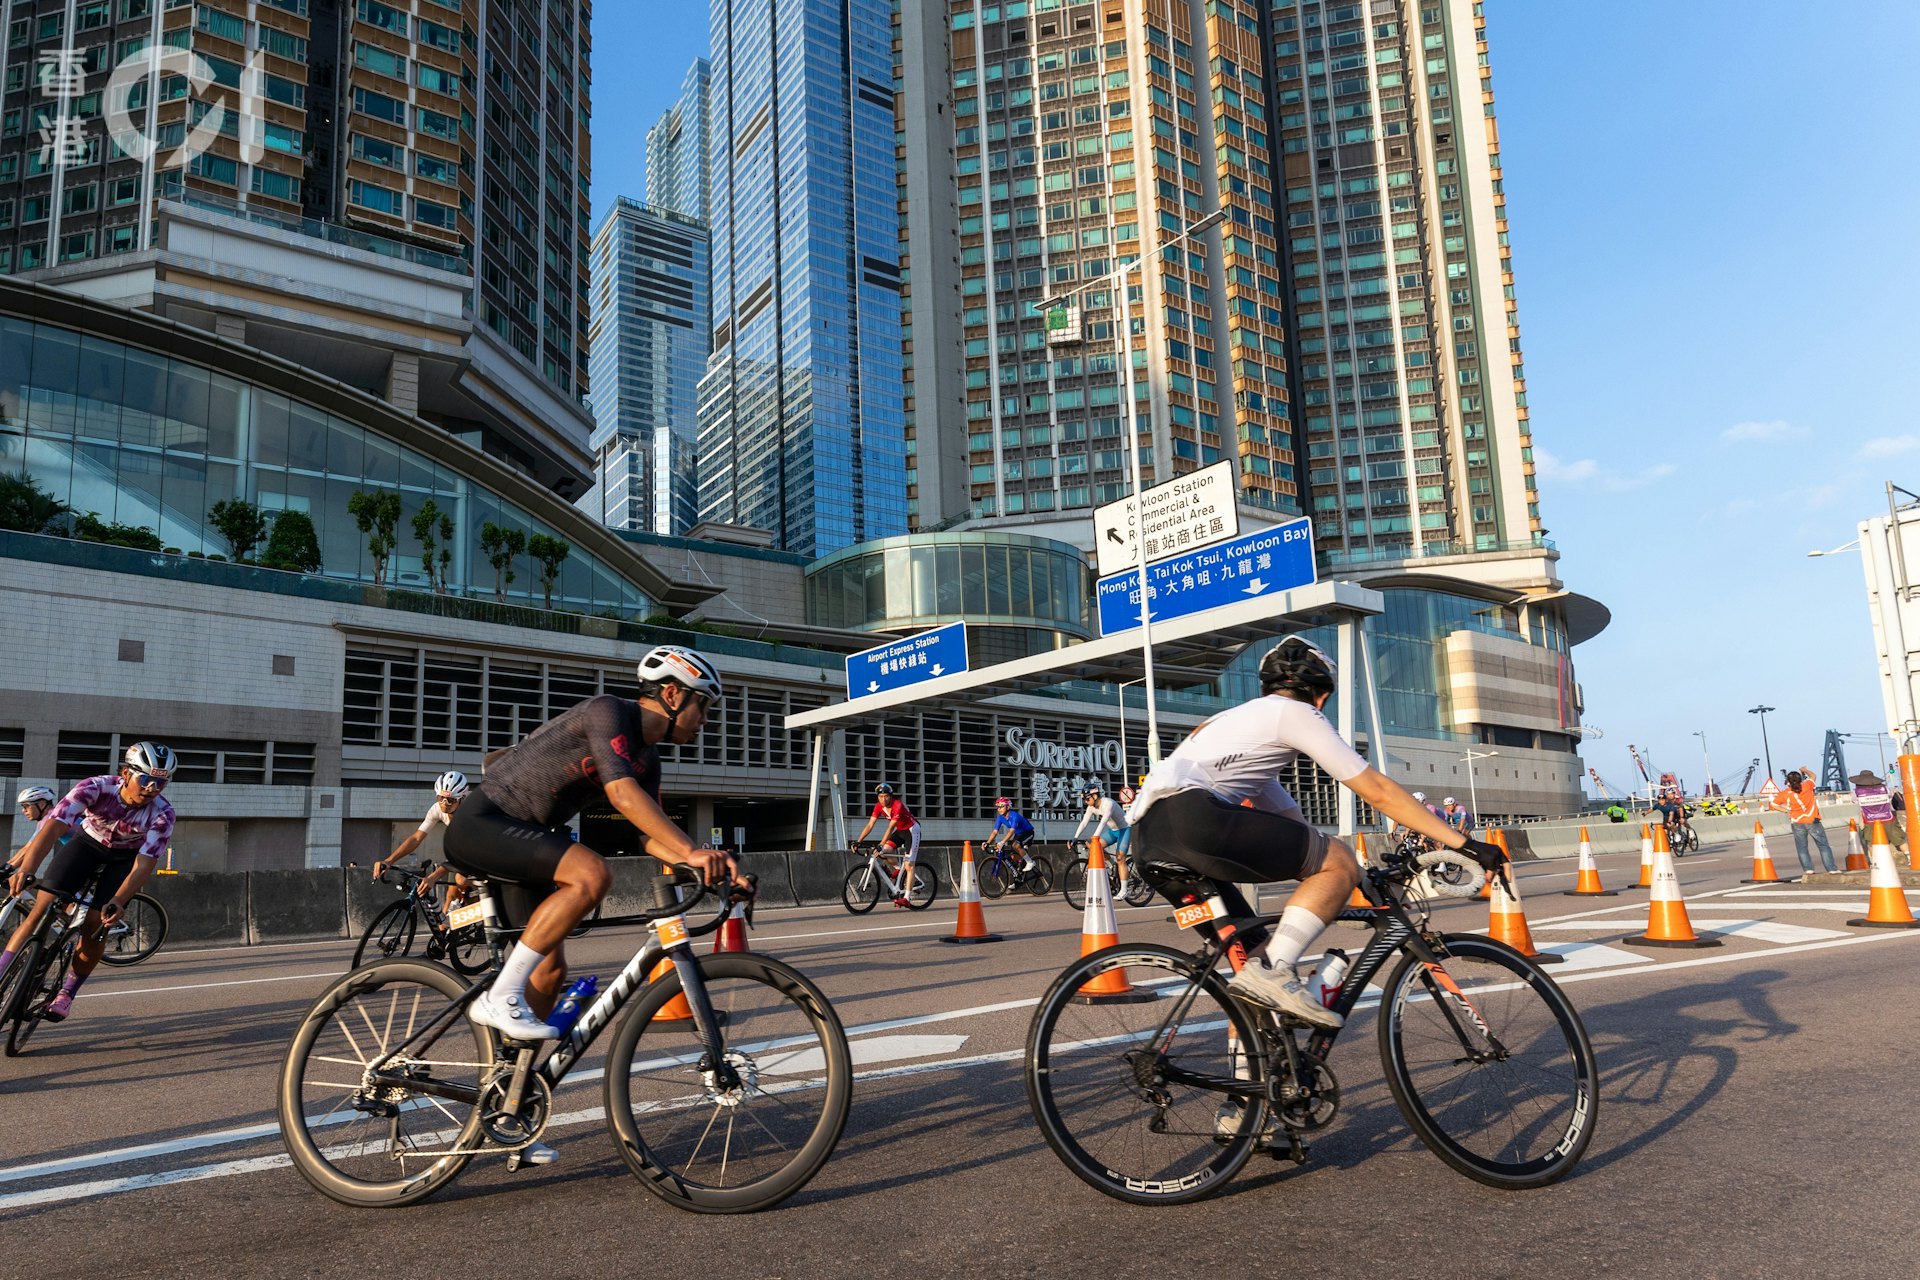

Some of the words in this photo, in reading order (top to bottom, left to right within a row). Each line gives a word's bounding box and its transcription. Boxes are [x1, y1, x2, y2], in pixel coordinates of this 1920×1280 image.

[1126, 491, 1170, 513] Kwloon
[1173, 475, 1214, 496] Station
[1128, 496, 1189, 526] Cmmercial
[1192, 493, 1200, 504] &
[1129, 512, 1187, 540] Rsidential
[1190, 505, 1215, 520] Area
[1100, 580, 1127, 596] Mong
[1129, 574, 1152, 587] K,
[1154, 565, 1170, 580] Tai
[1172, 559, 1194, 575] Kok
[1196, 551, 1223, 567] Tsui,
[1226, 535, 1280, 560] Kowloon
[1284, 526, 1309, 544] Bay
[867, 650, 888, 663] Airport
[889, 643, 914, 657] Express
[915, 635, 940, 649] Station
[502, 825, 545, 841] MAAP
[452, 906, 481, 925] 3384
[1178, 905, 1211, 925] 2881
[1450, 992, 1489, 1037] JAVA
